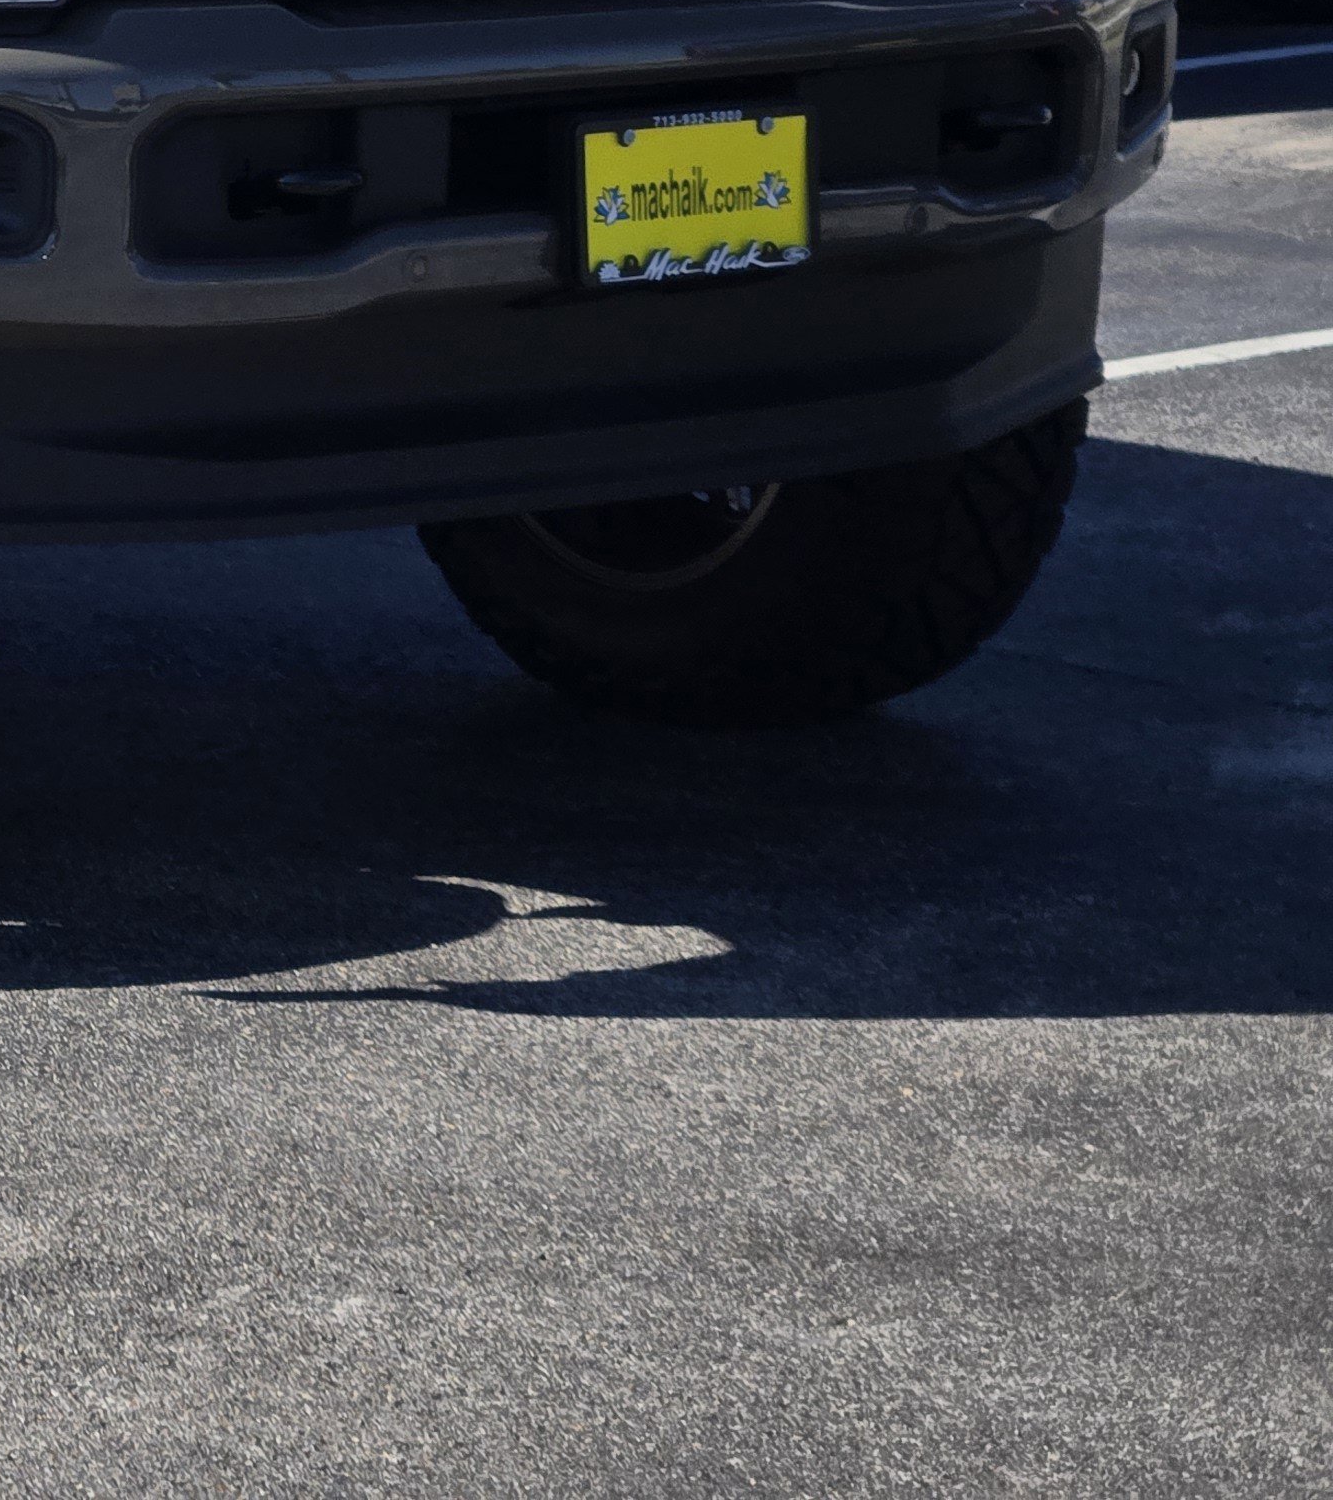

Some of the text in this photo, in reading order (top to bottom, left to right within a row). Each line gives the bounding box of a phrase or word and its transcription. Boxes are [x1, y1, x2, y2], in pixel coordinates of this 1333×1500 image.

[631, 166, 752, 221] machaik.com
[644, 249, 695, 281] Mac
[704, 242, 761, 275] Haik
